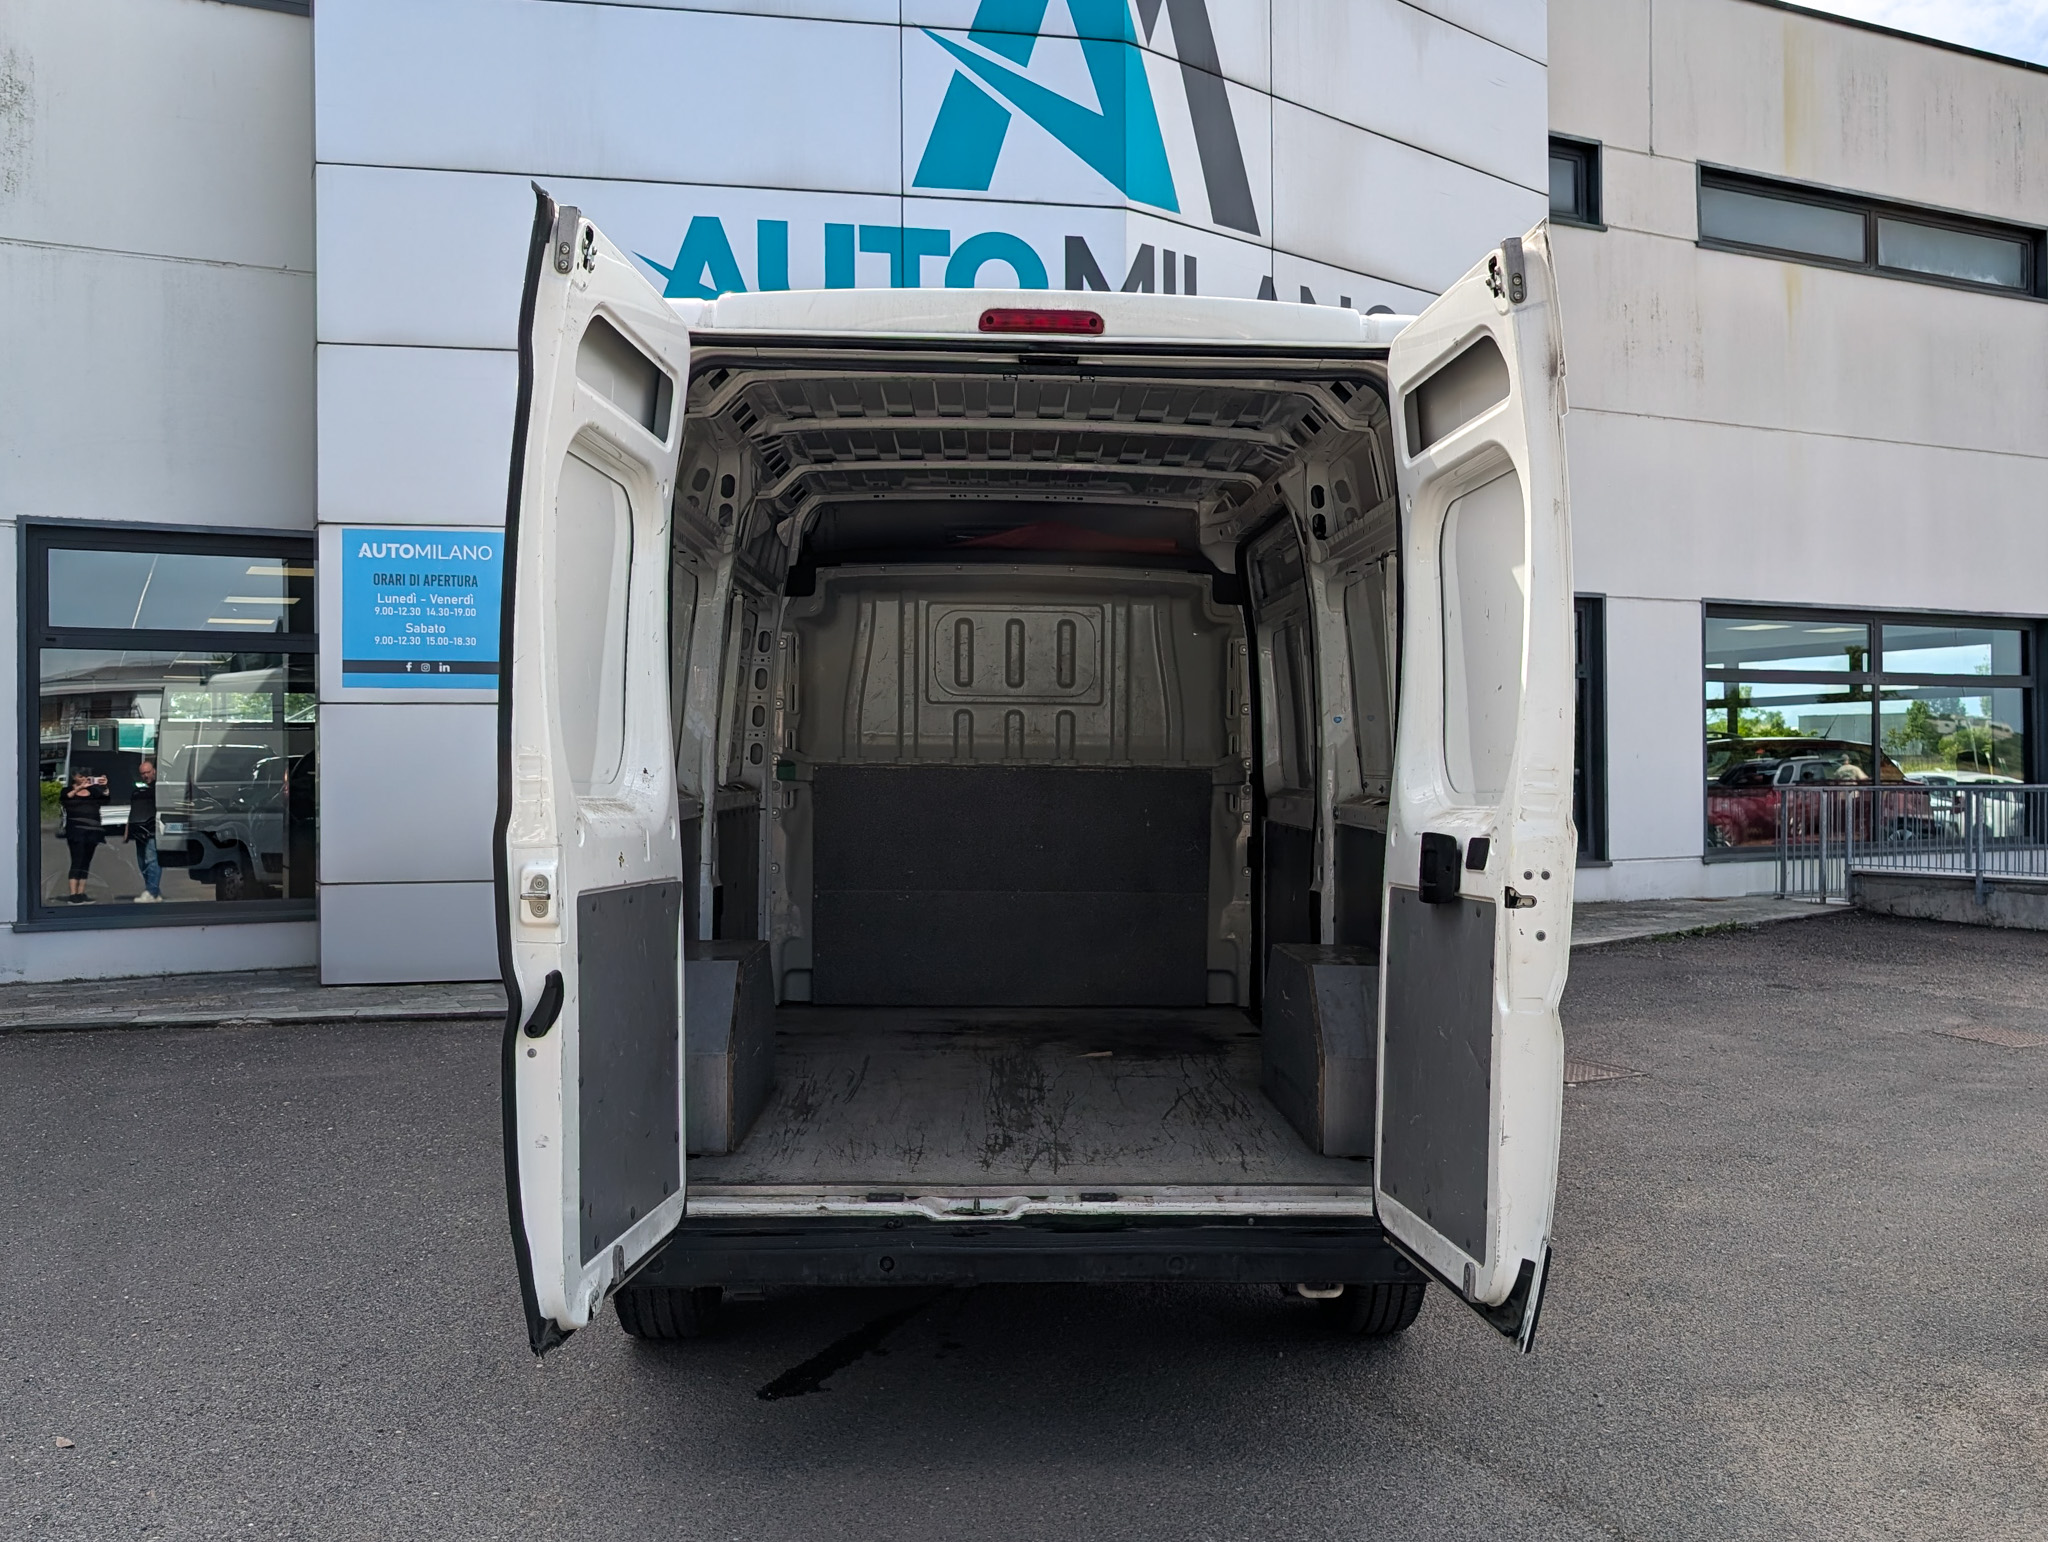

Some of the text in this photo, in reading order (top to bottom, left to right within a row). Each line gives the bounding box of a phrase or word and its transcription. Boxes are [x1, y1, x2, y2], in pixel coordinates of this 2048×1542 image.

[358, 542, 493, 561] AUTOMILANO
[373, 573, 479, 588] ORARI DI APERTURA
[377, 592, 417, 604] Lunedì
[429, 593, 474, 605] Venerdì
[374, 606, 477, 617] 9.00-12.30 14.30-19.00
[405, 622, 446, 634] Sabato
[374, 636, 477, 646] 9.00-12.30 15.00-18.30
